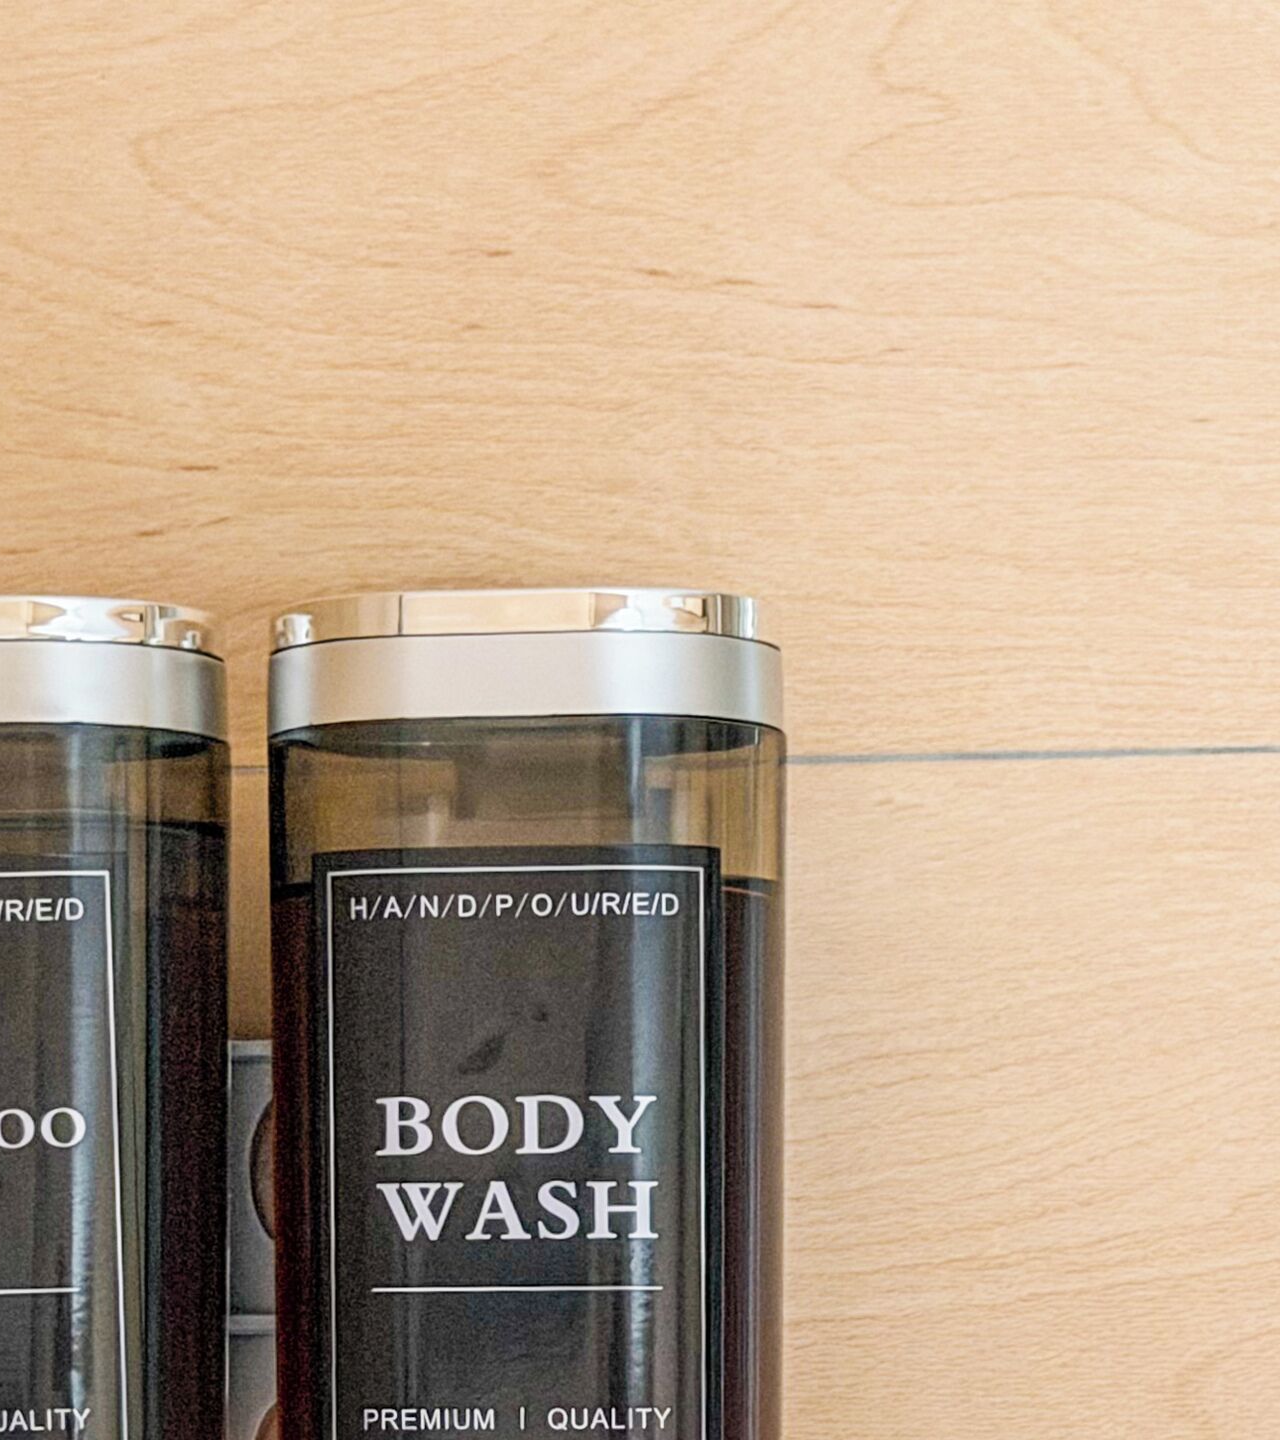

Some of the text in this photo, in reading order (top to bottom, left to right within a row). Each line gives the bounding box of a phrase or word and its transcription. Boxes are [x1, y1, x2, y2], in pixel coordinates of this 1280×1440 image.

[349, 891, 680, 921] H/A/N/D/P/O/U/R/E/D
[375, 1094, 658, 1157] BODY
[375, 1180, 660, 1243] WASH
[363, 1408, 496, 1432] PREMIUM
[547, 1406, 672, 1432] QUALITY
